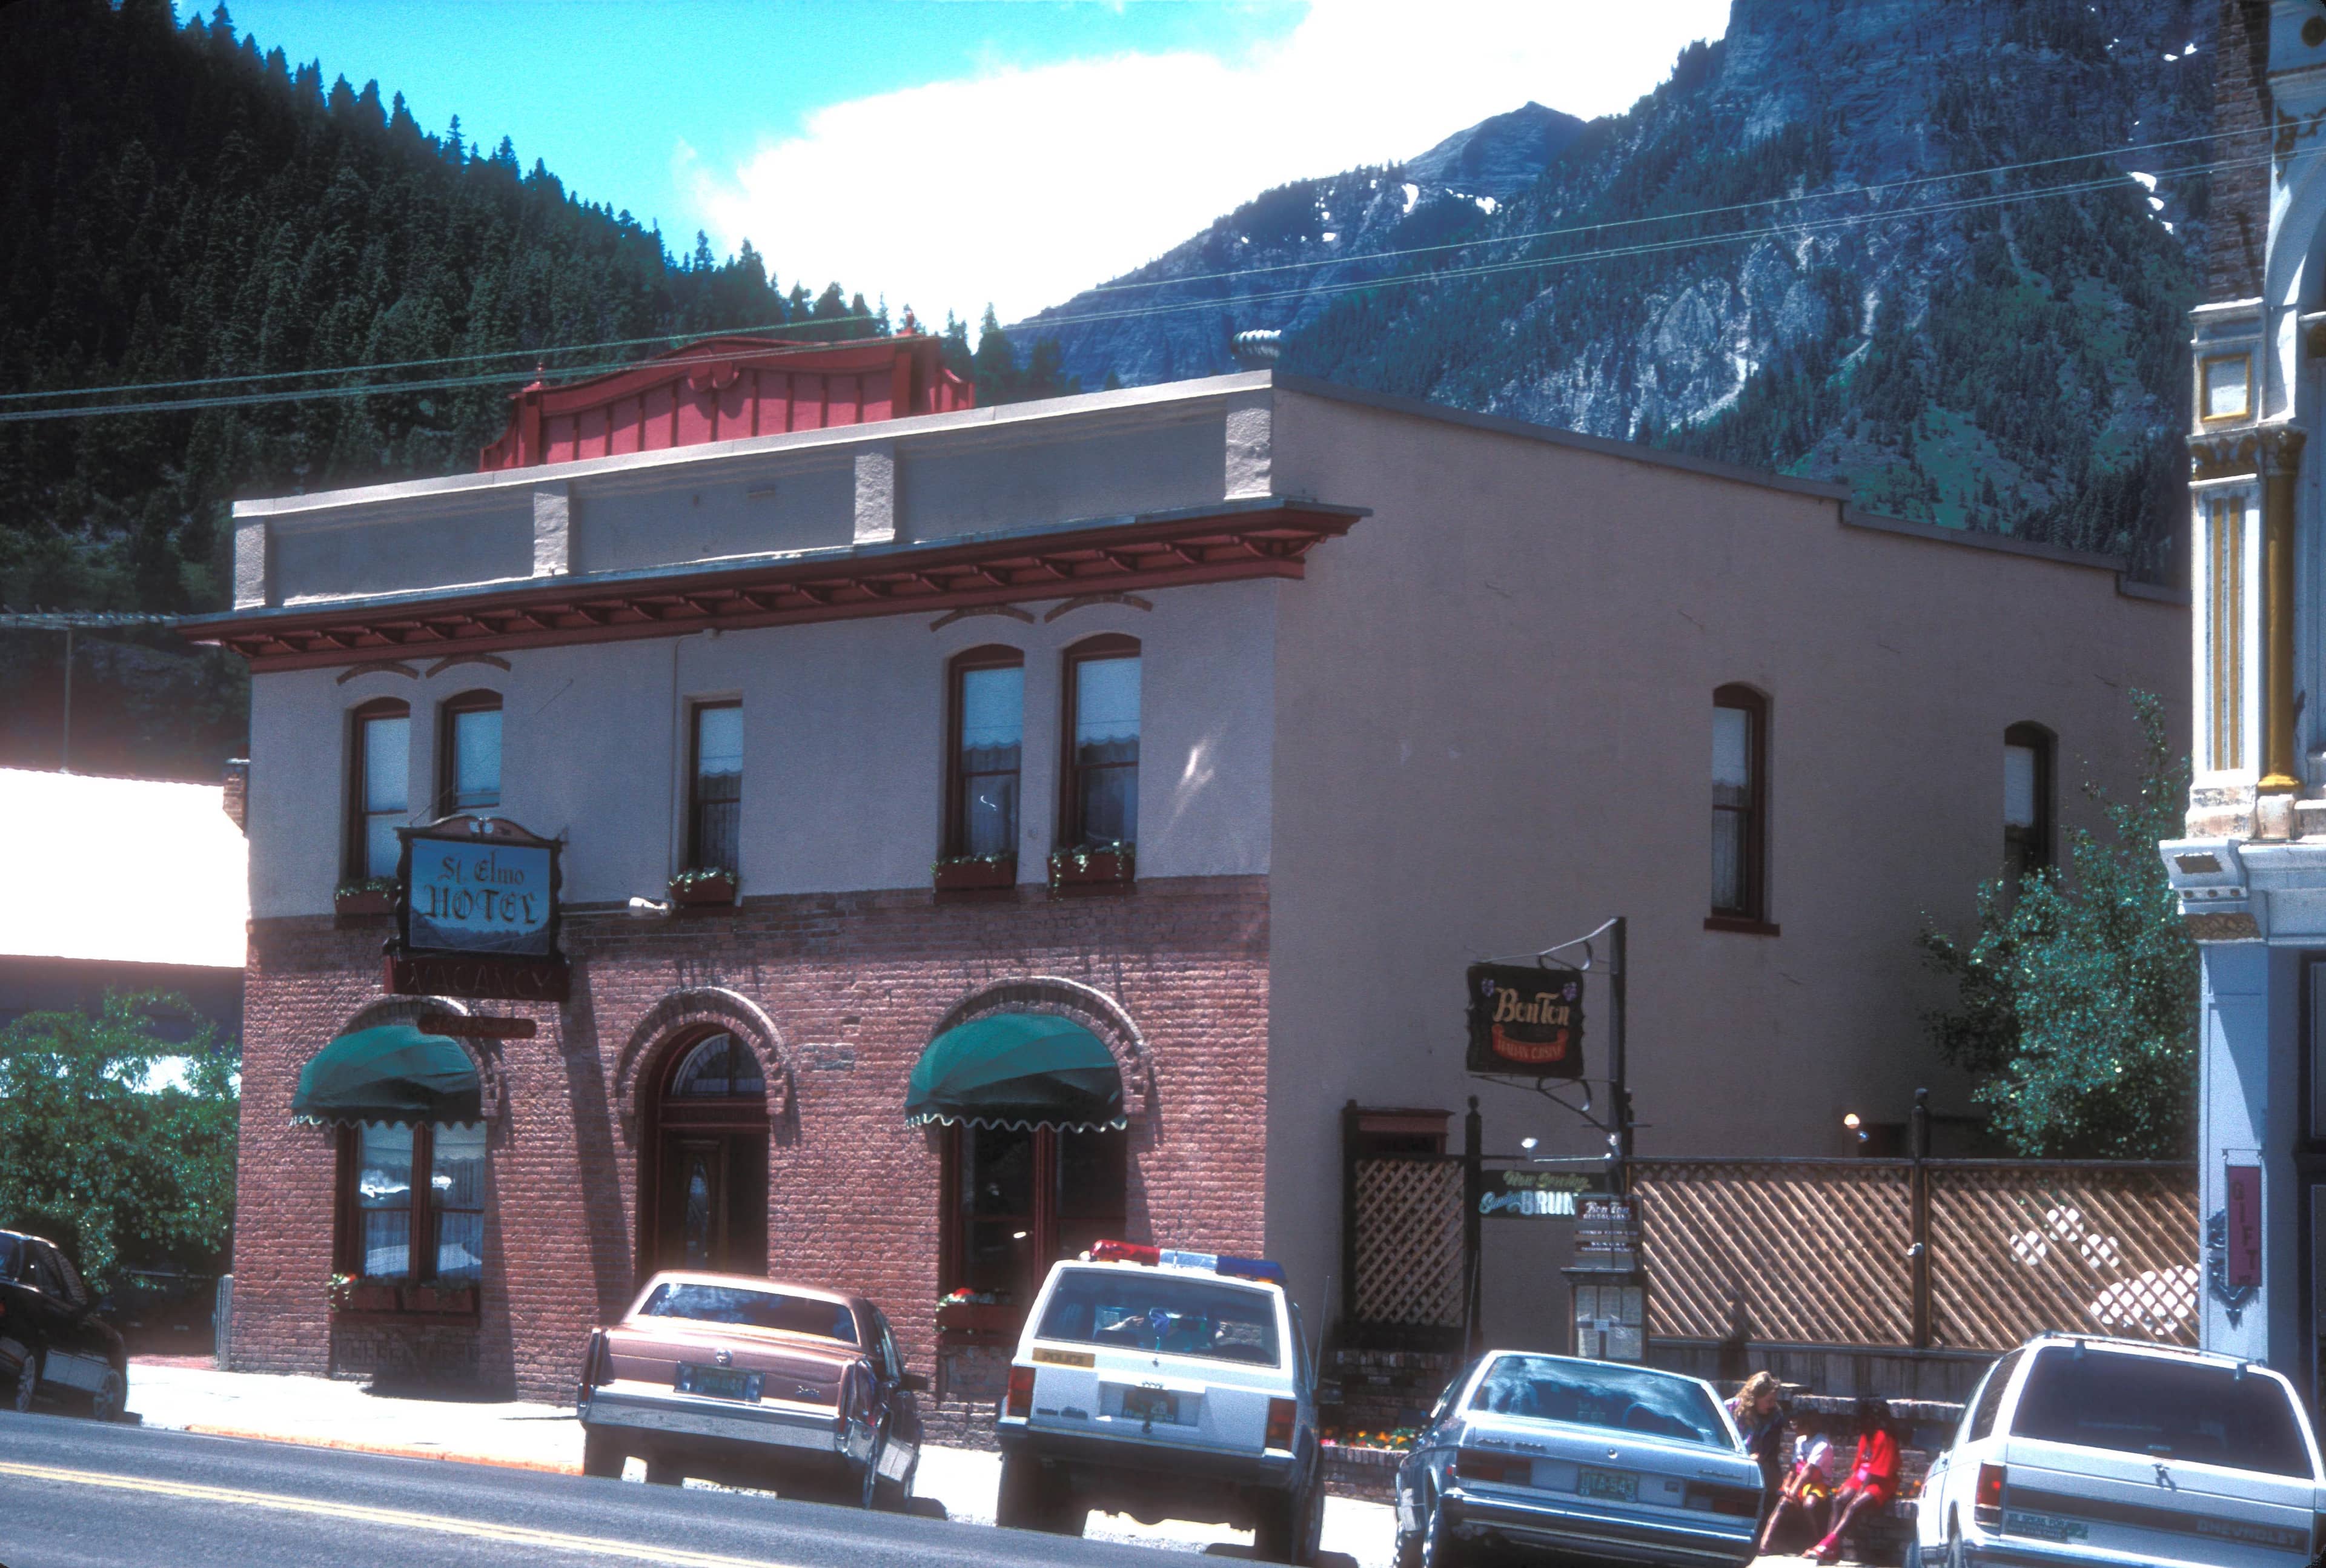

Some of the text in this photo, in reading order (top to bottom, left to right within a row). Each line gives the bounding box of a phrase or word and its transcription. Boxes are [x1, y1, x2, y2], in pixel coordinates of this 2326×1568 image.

[474, 849, 525, 885] Elmo
[422, 885, 539, 925] HOTEL
[407, 962, 553, 998] VACANCY
[2231, 1177, 2259, 1271] GIFT
[1041, 1351, 1086, 1366] POLICE
